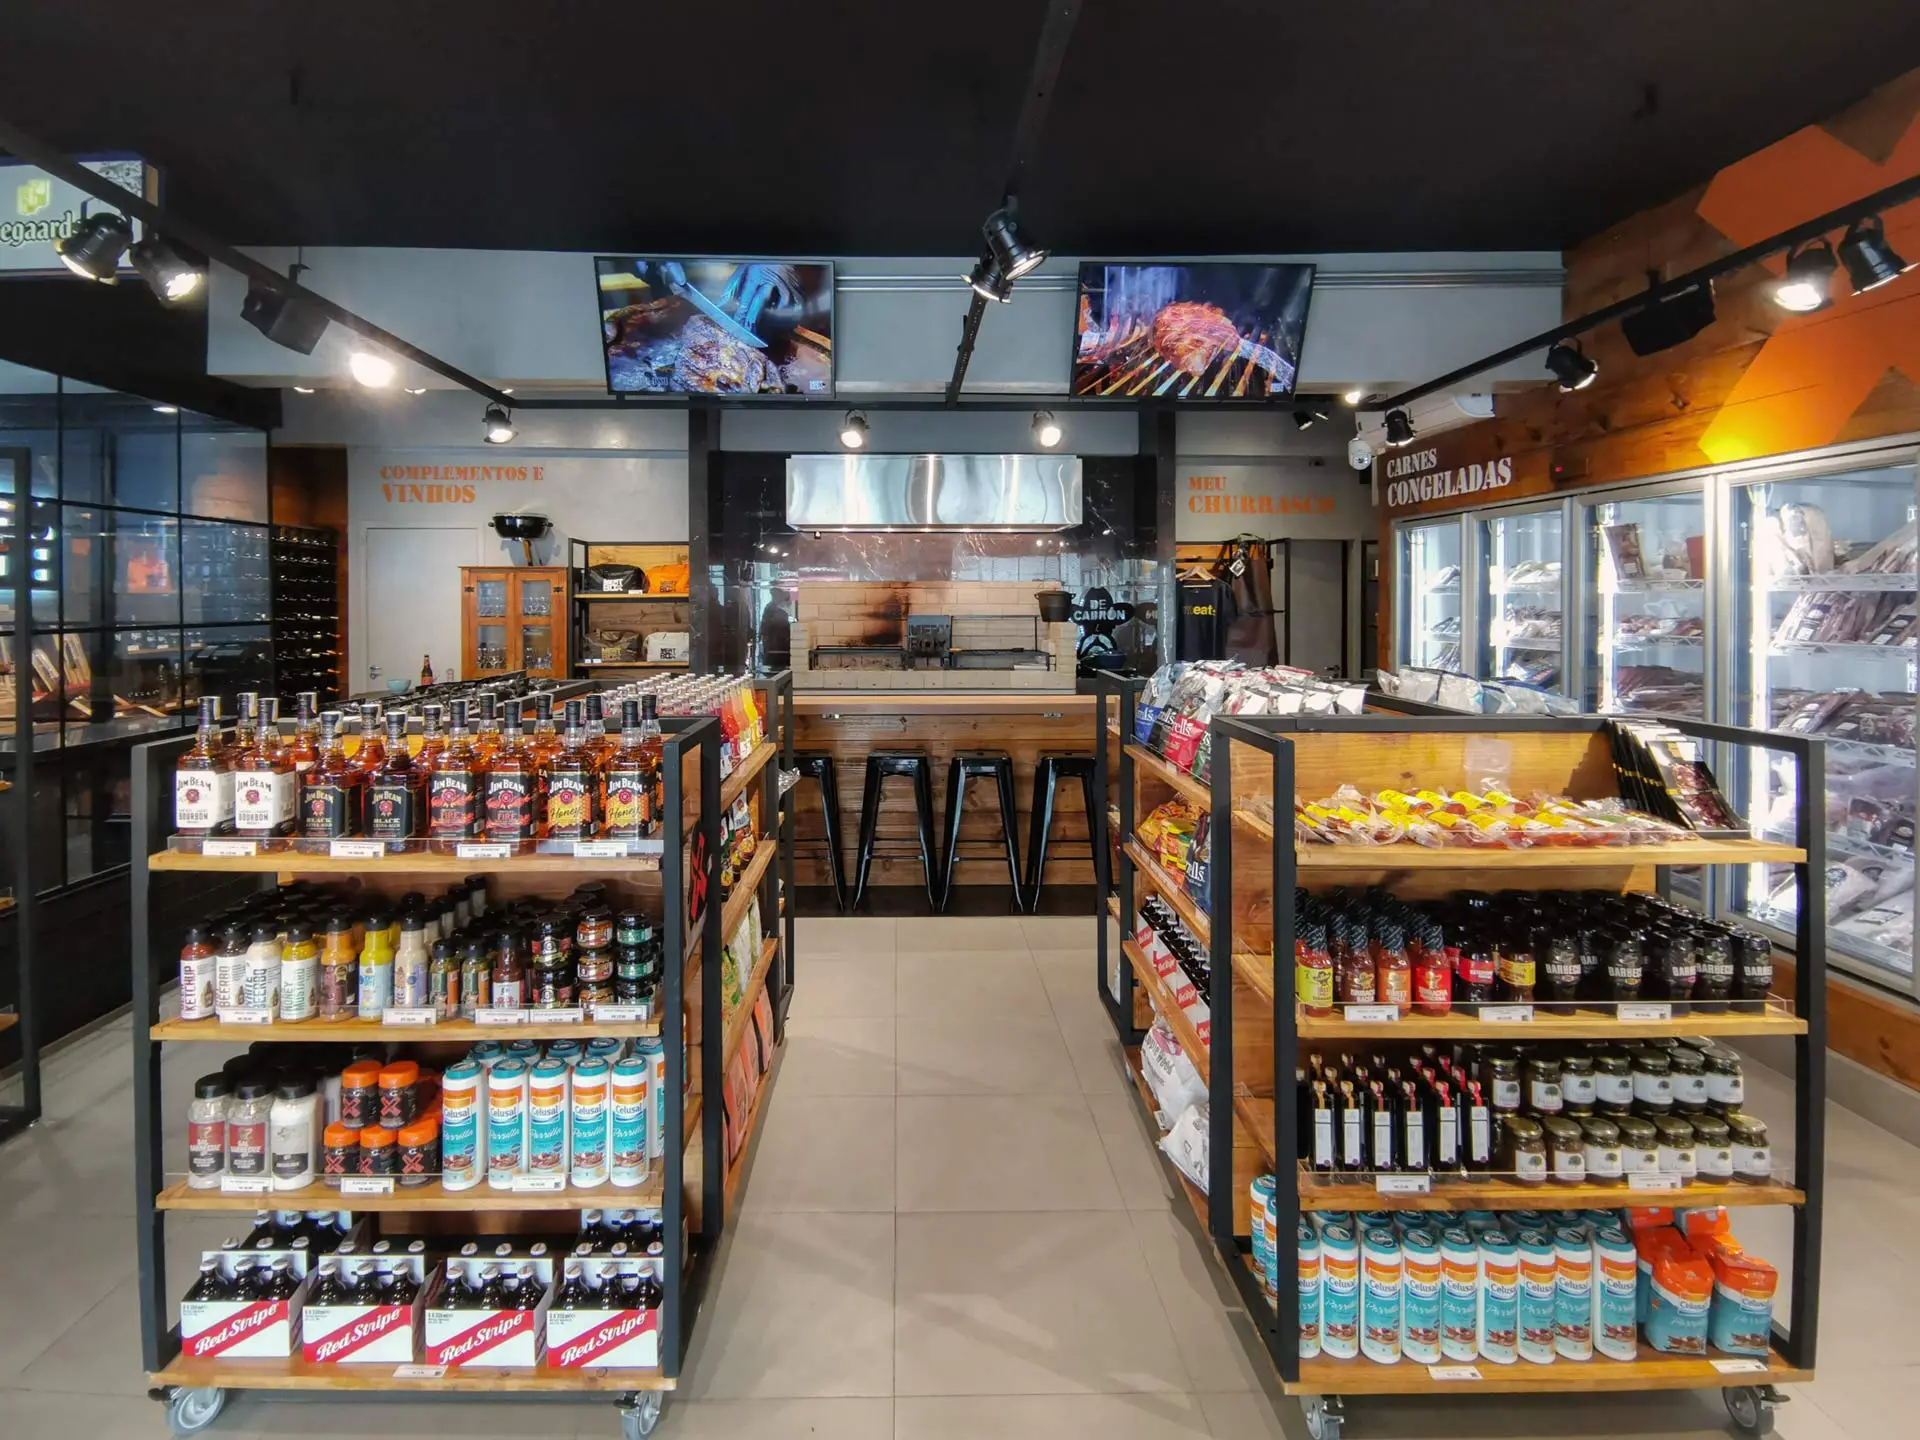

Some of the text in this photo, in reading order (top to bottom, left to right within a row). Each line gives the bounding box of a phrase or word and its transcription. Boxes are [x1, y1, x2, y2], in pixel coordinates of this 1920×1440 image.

[1386, 448, 1437, 478] CARNES
[380, 465, 544, 480] COMPLEMENTOS E
[1189, 476, 1227, 491] MEU
[1387, 457, 1512, 507] CONGELADAS
[381, 483, 476, 504] VINHOS
[1188, 494, 1336, 514] CHURRASCO
[1089, 599, 1107, 610] DE
[177, 776, 212, 792] JIM BEAM
[237, 777, 272, 792] JIM BEAM
[432, 777, 468, 793] JIM BEAM
[488, 779, 525, 794] JIM BEAM
[549, 778, 585, 794] JIM BEAM
[608, 778, 643, 794] JIM BEAM
[305, 790, 334, 804] JIM BEAM
[372, 791, 402, 804] JIM BEAM
[440, 811, 457, 820] FIRE
[497, 813, 515, 821] FIRE
[550, 805, 581, 819] Honey
[608, 805, 640, 819] Honey
[184, 966, 196, 1011] KETCHUP
[443, 1107, 470, 1118] Celusal
[490, 1106, 517, 1117] Celusal
[531, 1105, 558, 1116] Celusal
[574, 1103, 602, 1114] Celusal
[615, 1102, 642, 1113] Celusal
[195, 1303, 278, 1356] Red Stripe
[316, 1308, 401, 1361] Red Stripe
[440, 1313, 523, 1365] Red Stripe
[561, 1313, 646, 1366] Red Stripe
